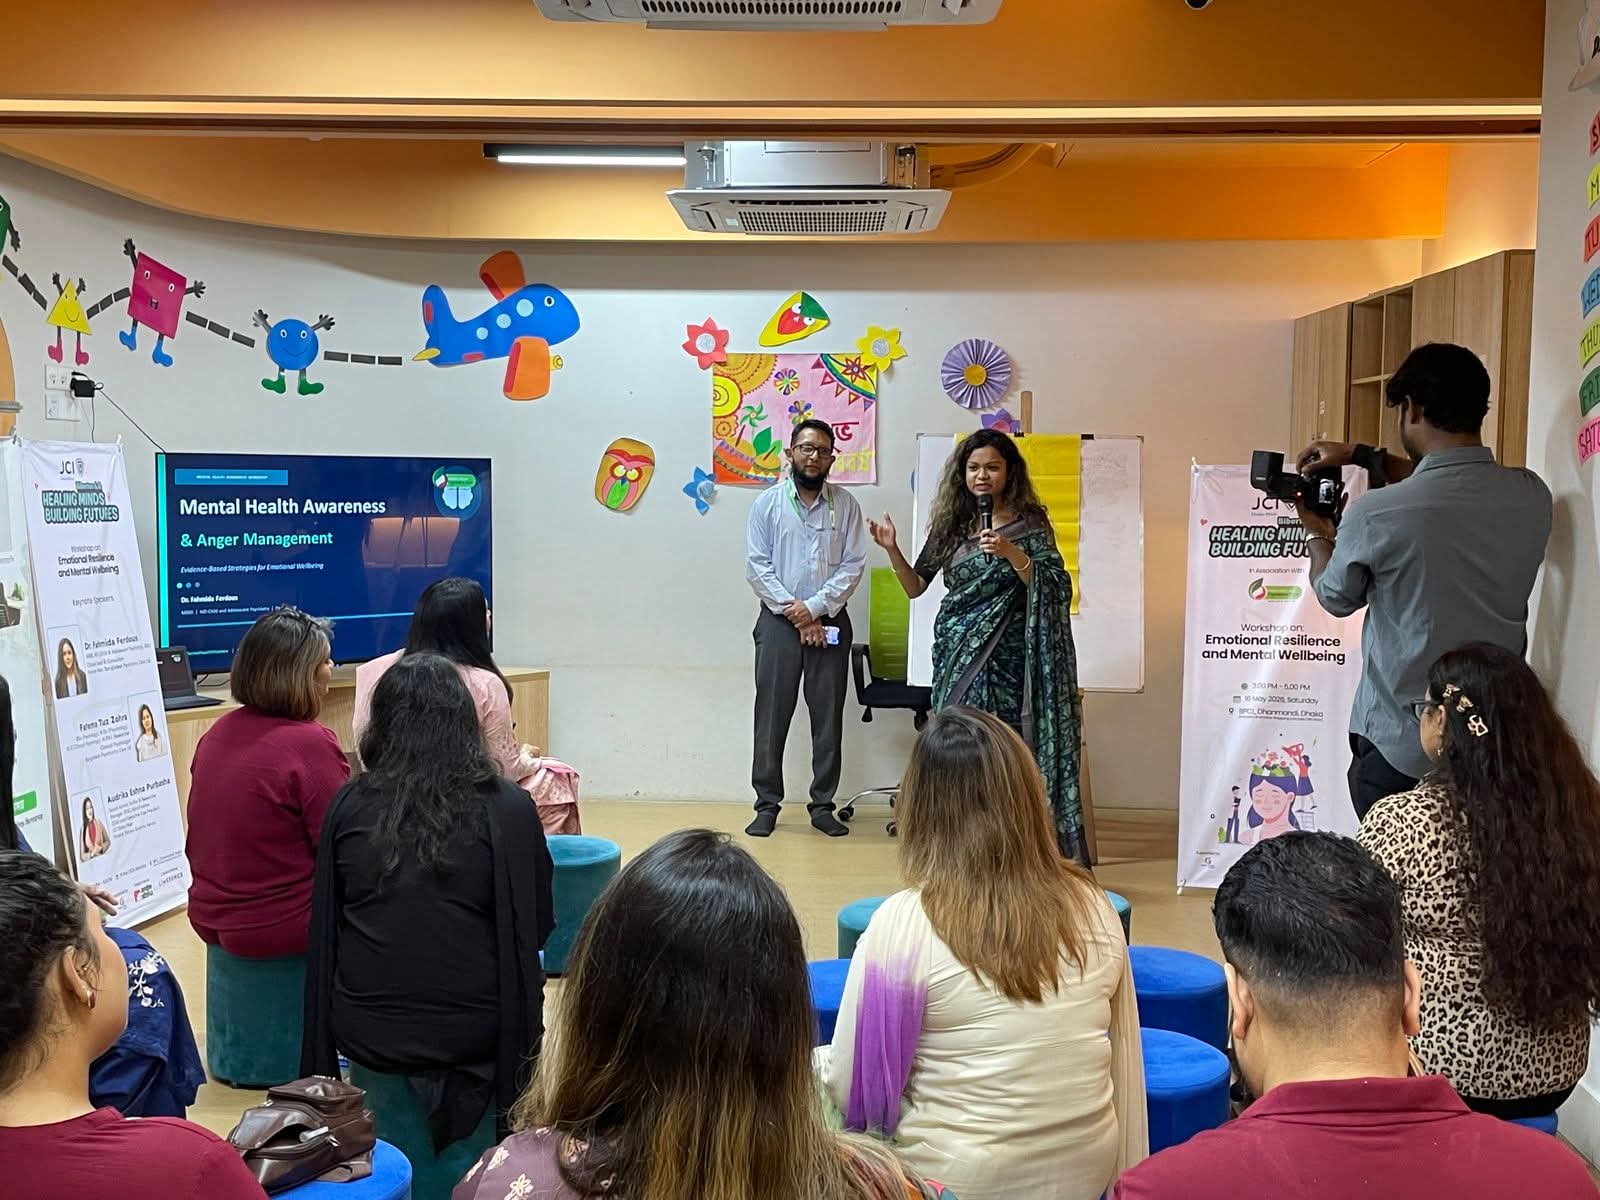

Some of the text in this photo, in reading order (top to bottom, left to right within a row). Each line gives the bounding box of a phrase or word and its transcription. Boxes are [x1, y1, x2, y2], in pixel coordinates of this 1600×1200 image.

[832, 421, 860, 441] ভ
[60, 460, 75, 474] JCI
[42, 490, 106, 507] HEALING MINDS
[1251, 496, 1279, 510] JCI
[180, 498, 386, 515] Mental Health Awareness
[45, 506, 82, 523] BUILDING
[180, 532, 333, 550] & Anger Management
[1210, 526, 1306, 542] HEALING MIN
[1210, 542, 1281, 558] BUILDING
[58, 555, 88, 565] Emotional
[58, 567, 71, 577] and
[71, 566, 92, 576] Mental
[180, 565, 227, 574] Evidence-Based
[228, 564, 257, 573] Strategies
[257, 564, 266, 573] for
[266, 563, 296, 571] Emotional
[1240, 623, 1304, 634] Workshop on:
[1205, 634, 1341, 647] Emotional Resilience
[1202, 649, 1346, 666] and Mental Wellbeing
[1287, 697, 1319, 706] Saturday
